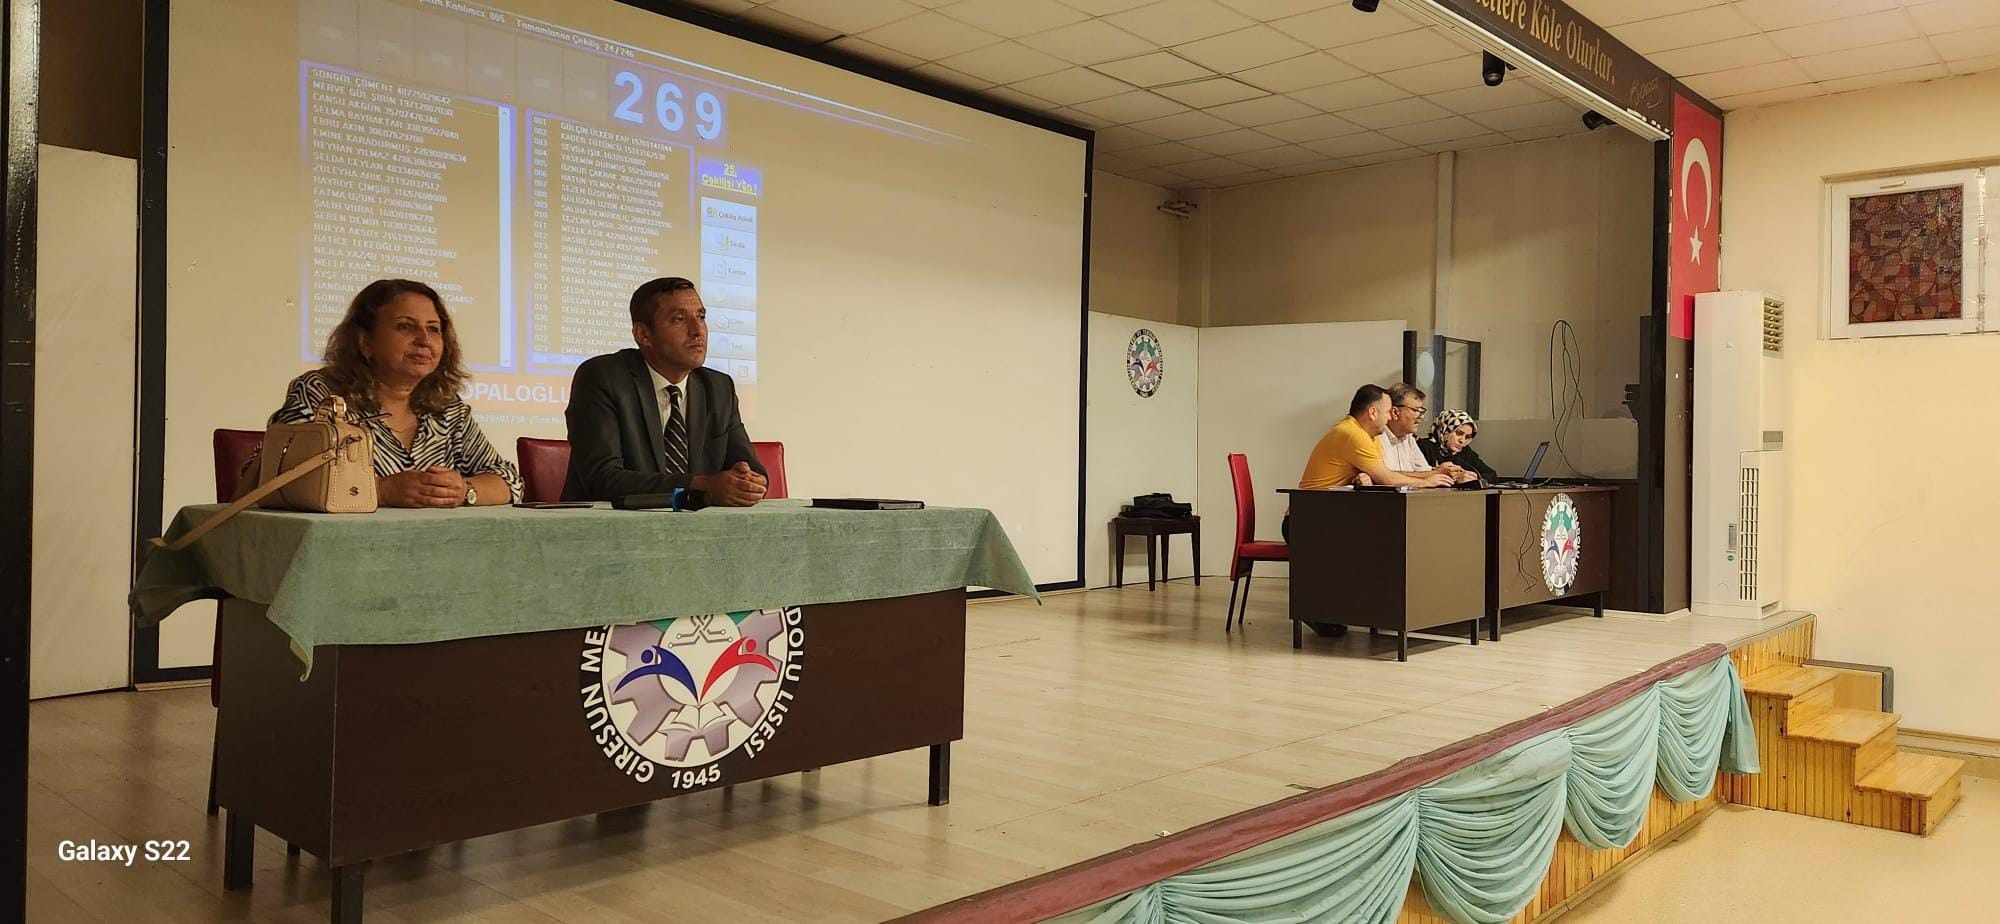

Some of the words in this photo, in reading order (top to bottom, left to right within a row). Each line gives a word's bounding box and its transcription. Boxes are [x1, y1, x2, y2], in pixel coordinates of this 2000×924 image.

[1530, 0, 1562, 52] Köle
[312, 104, 344, 118] SELMA
[614, 71, 722, 140] 269
[580, 624, 610, 673] ME
[784, 606, 804, 682] DOLU
[671, 764, 721, 788] 1945
